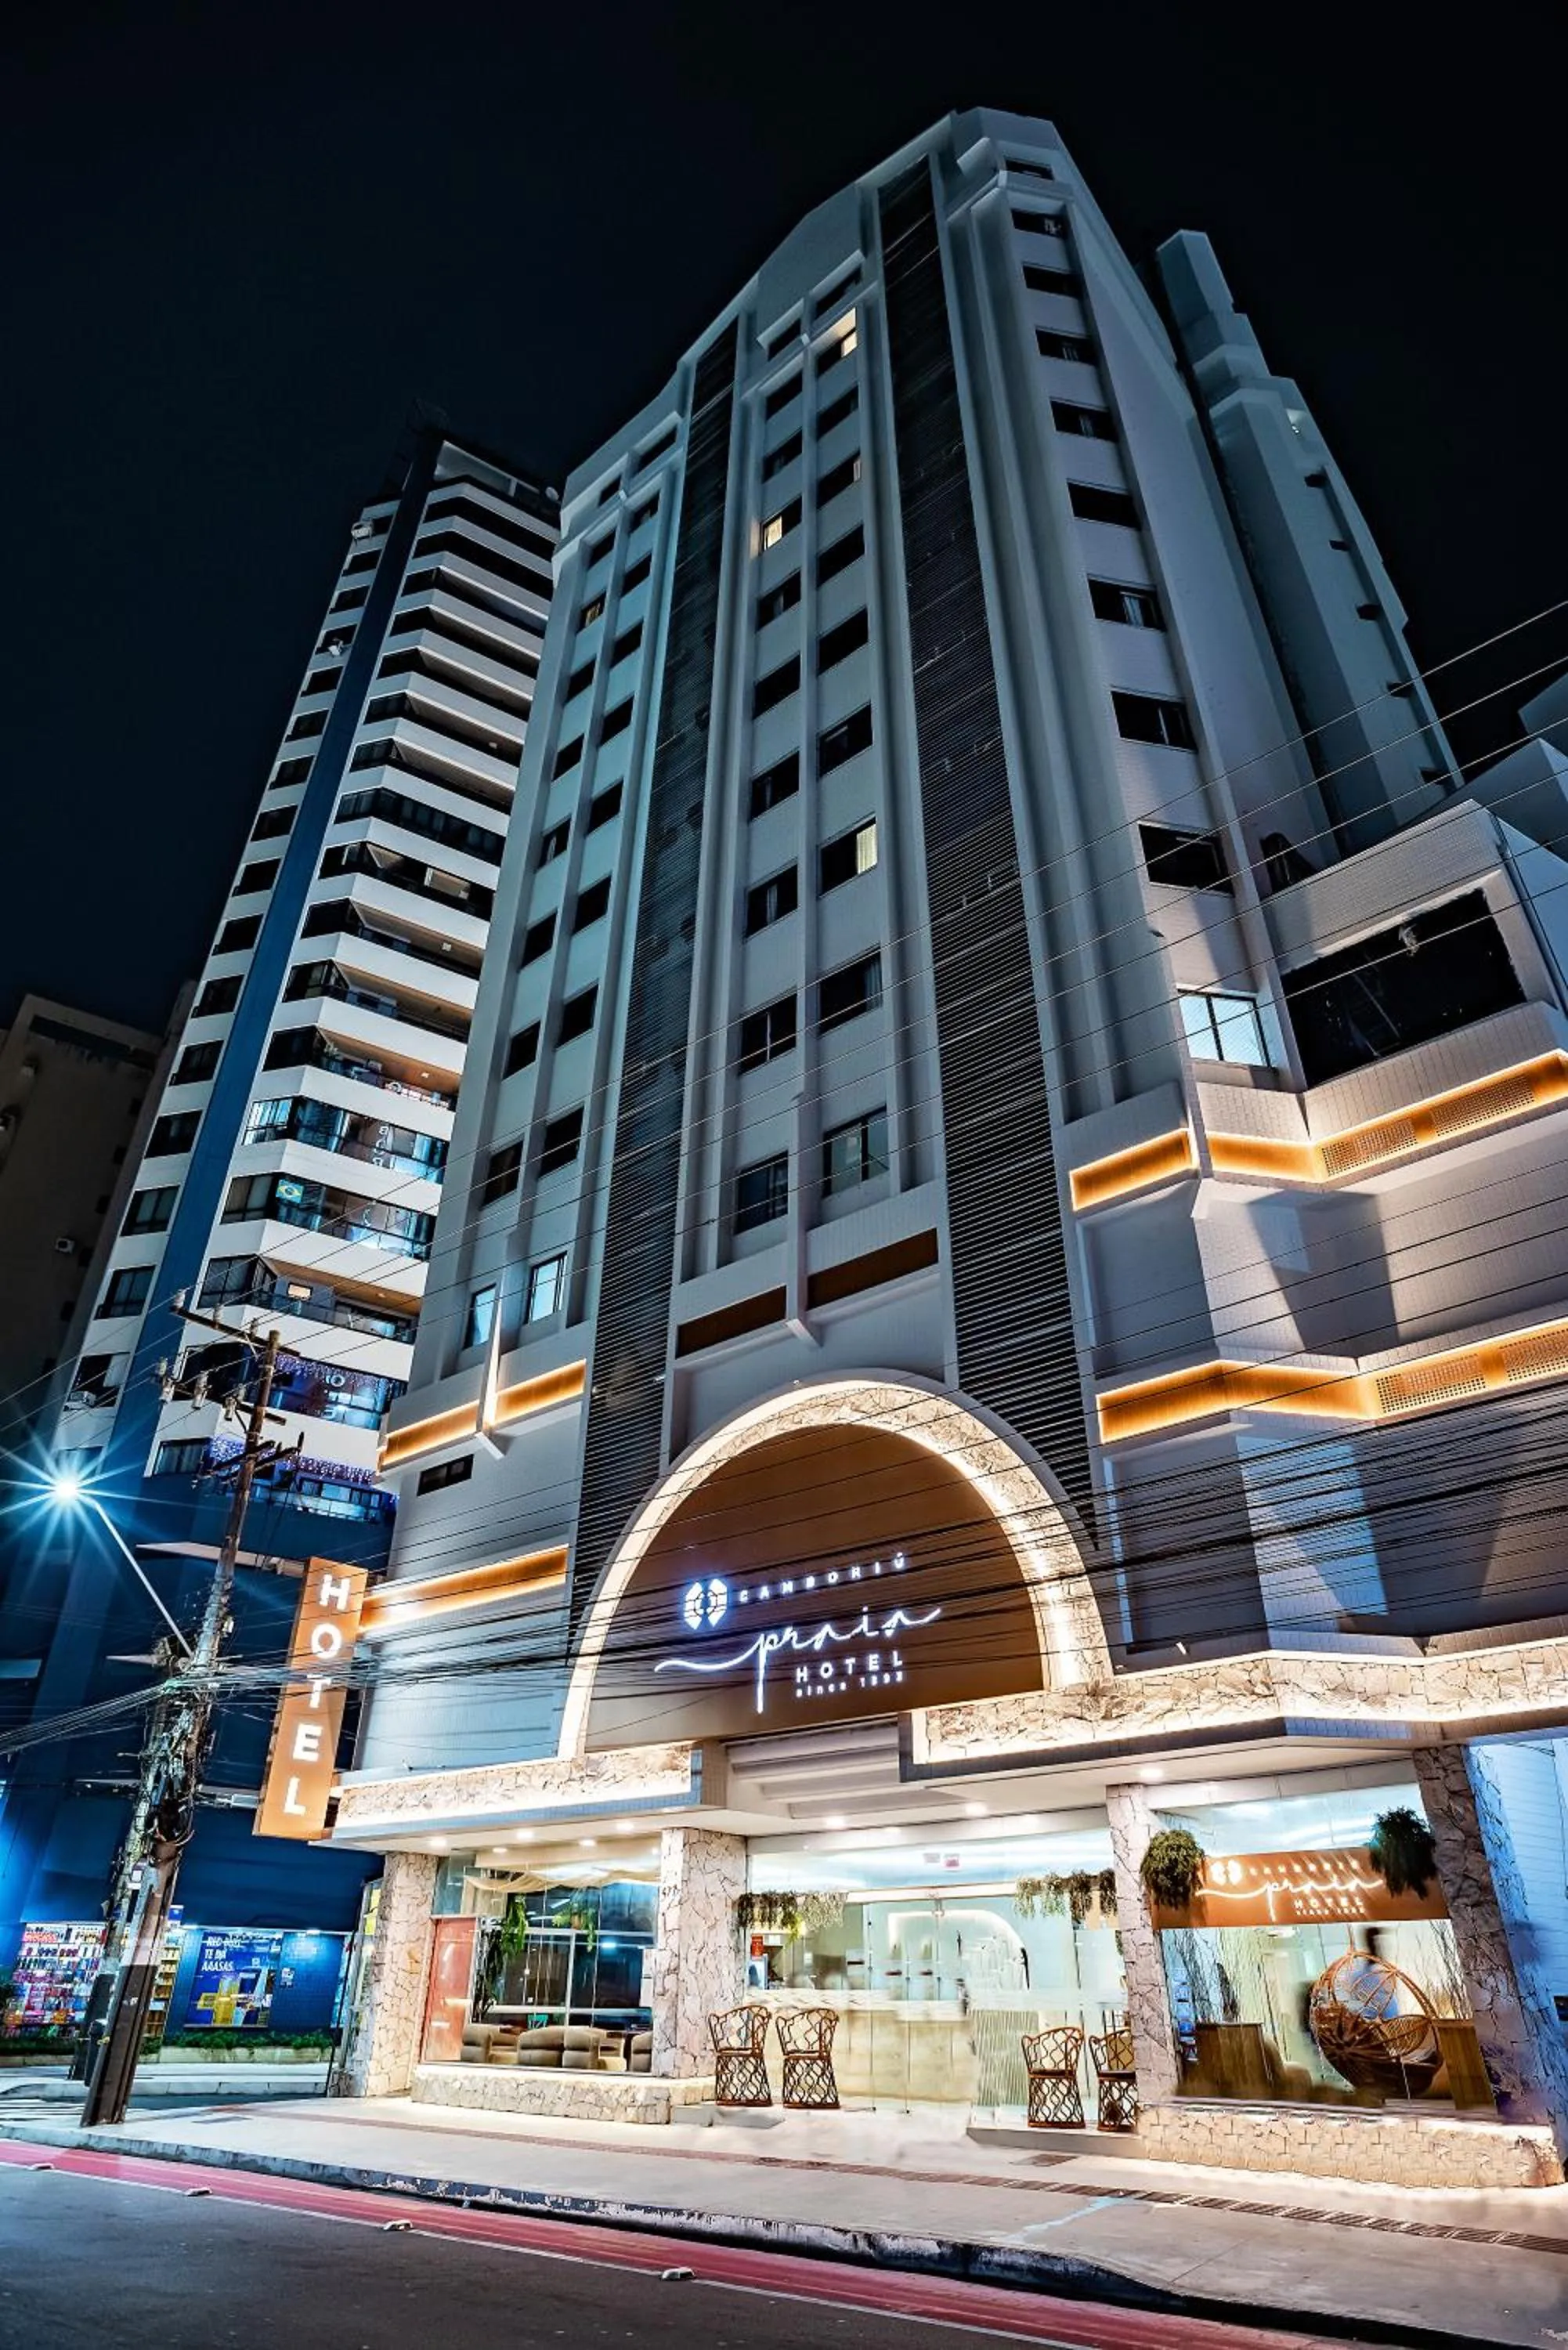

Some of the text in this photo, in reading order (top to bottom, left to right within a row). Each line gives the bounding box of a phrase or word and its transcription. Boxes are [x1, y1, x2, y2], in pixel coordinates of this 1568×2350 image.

[283, 1573, 351, 1816] HOTEL
[654, 1606, 941, 1714] praia
[795, 1650, 903, 1683] HOTEL
[1293, 1896, 1364, 1909] HOTEL
